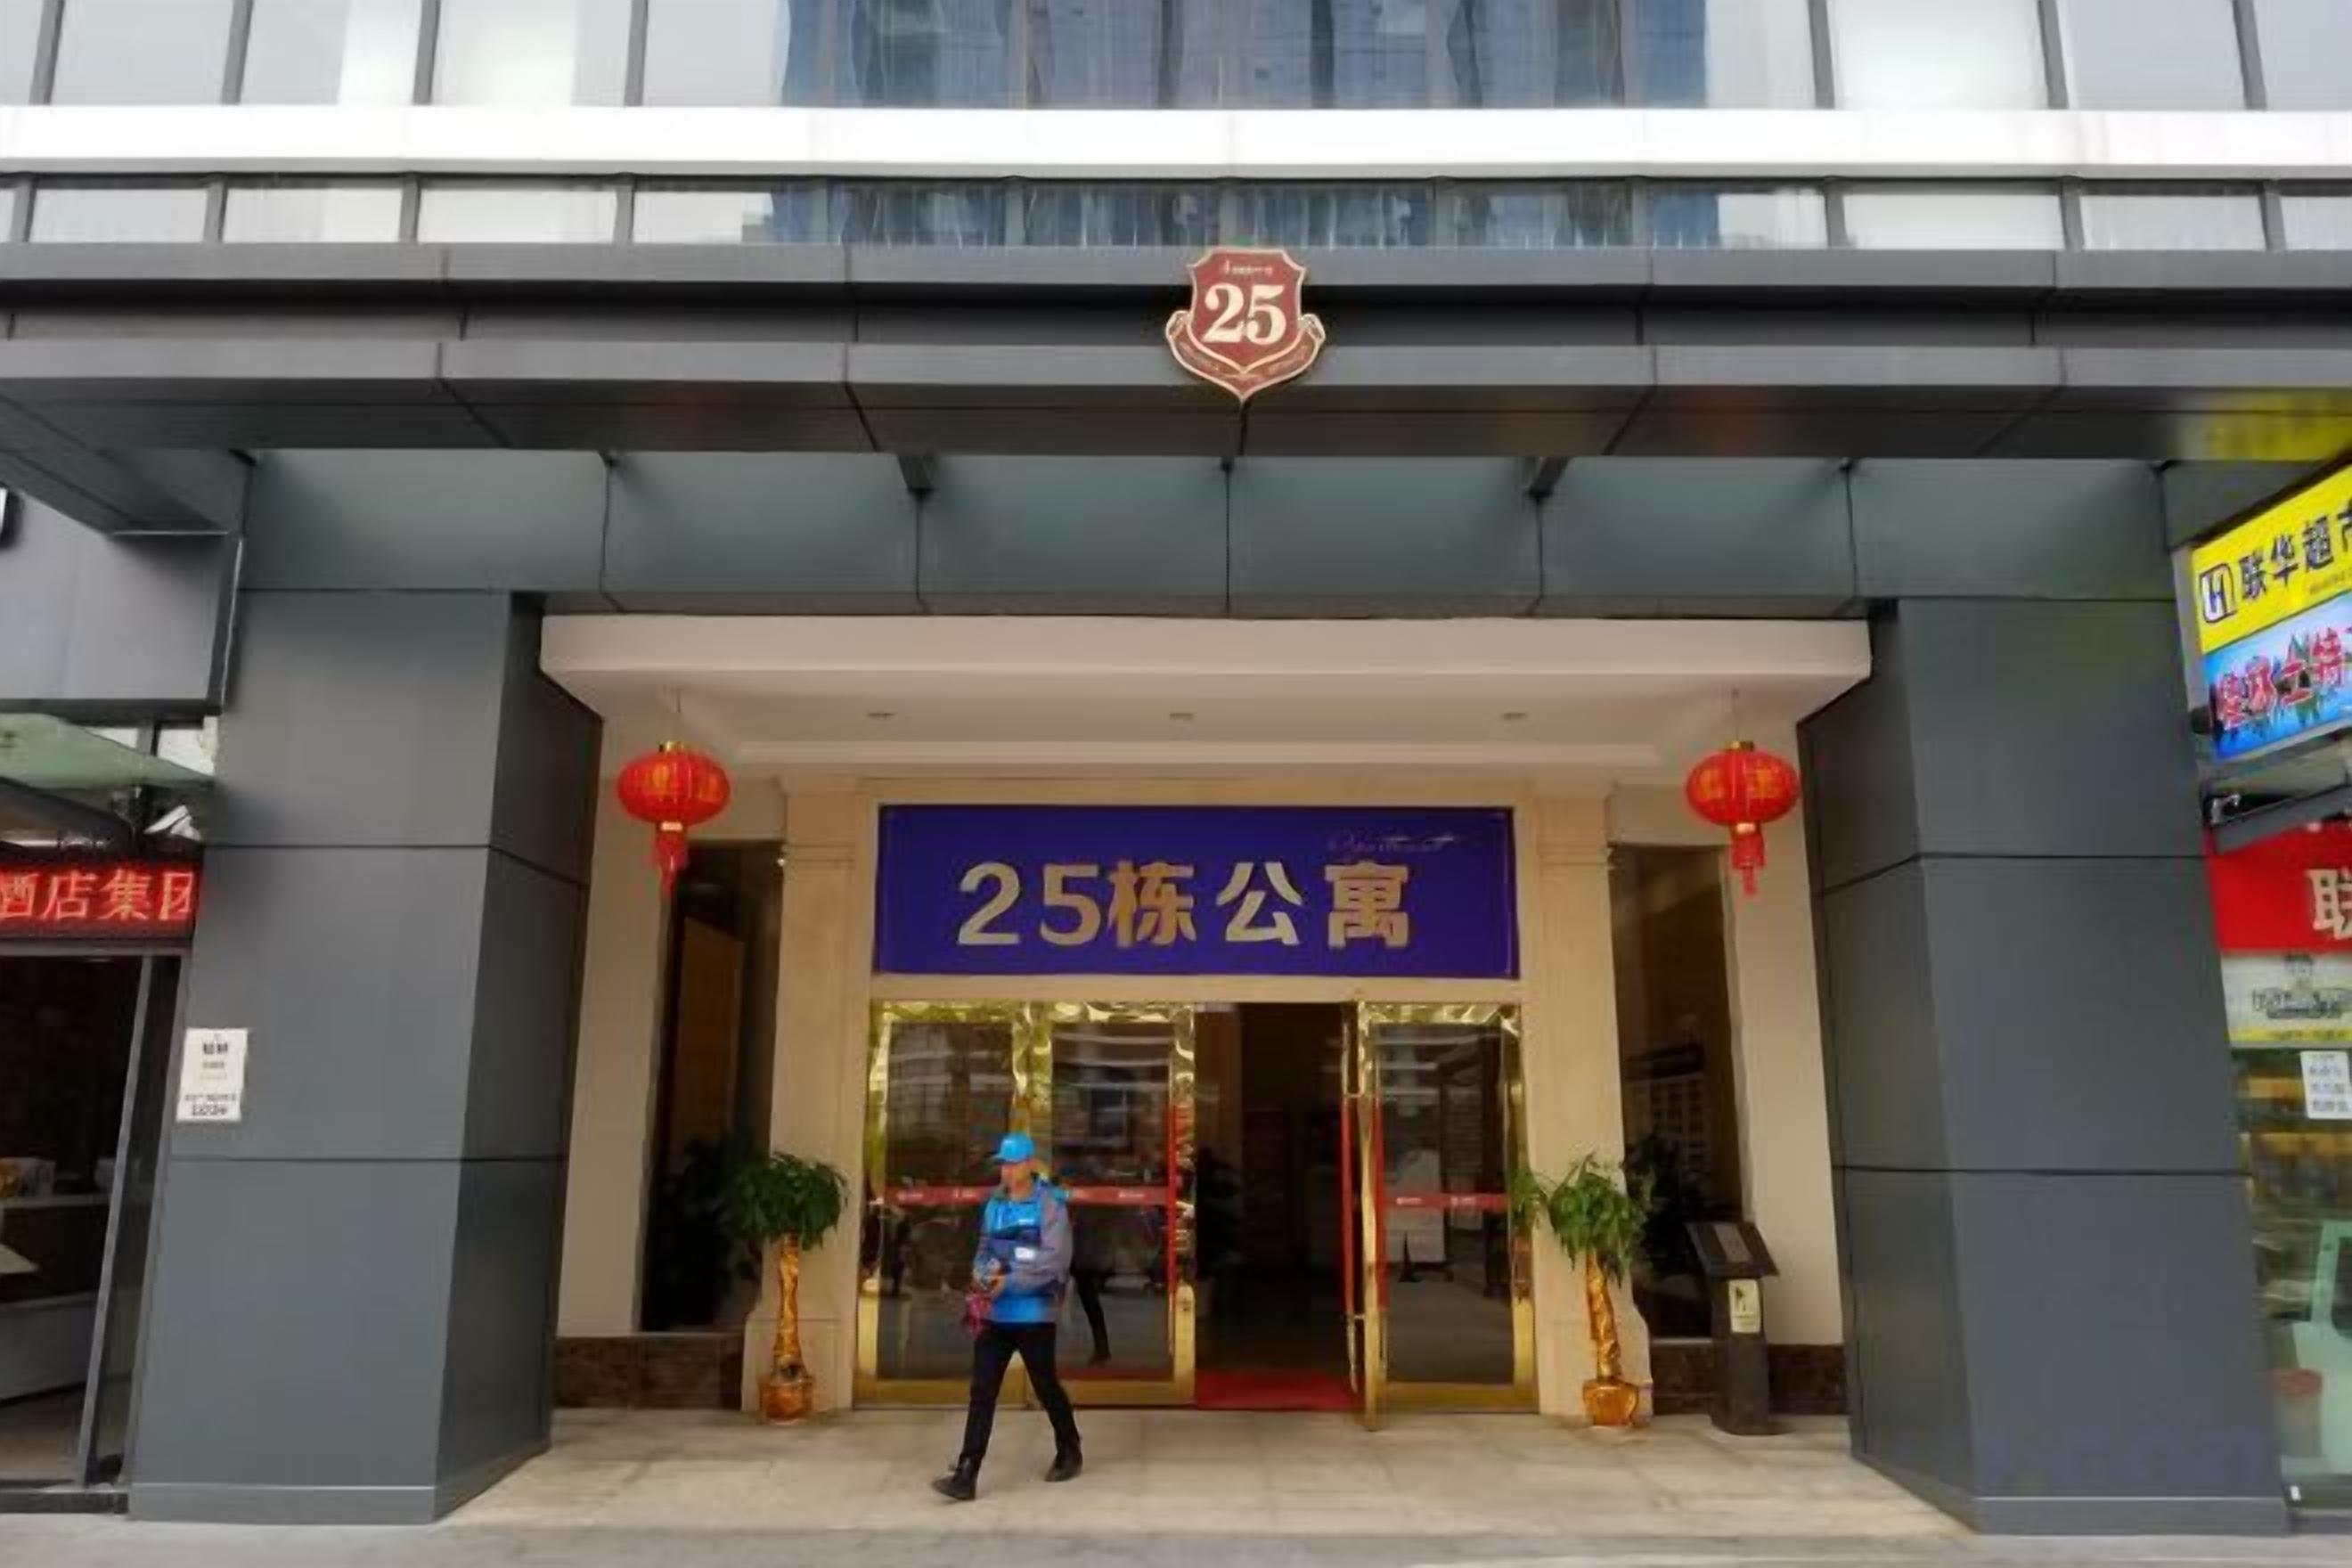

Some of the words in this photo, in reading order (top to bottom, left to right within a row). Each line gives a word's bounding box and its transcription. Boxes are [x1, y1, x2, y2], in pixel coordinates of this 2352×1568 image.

[1202, 282, 1286, 345] 25
[0, 869, 193, 920] 酒店集团
[958, 859, 1411, 949] 25栋公寓
